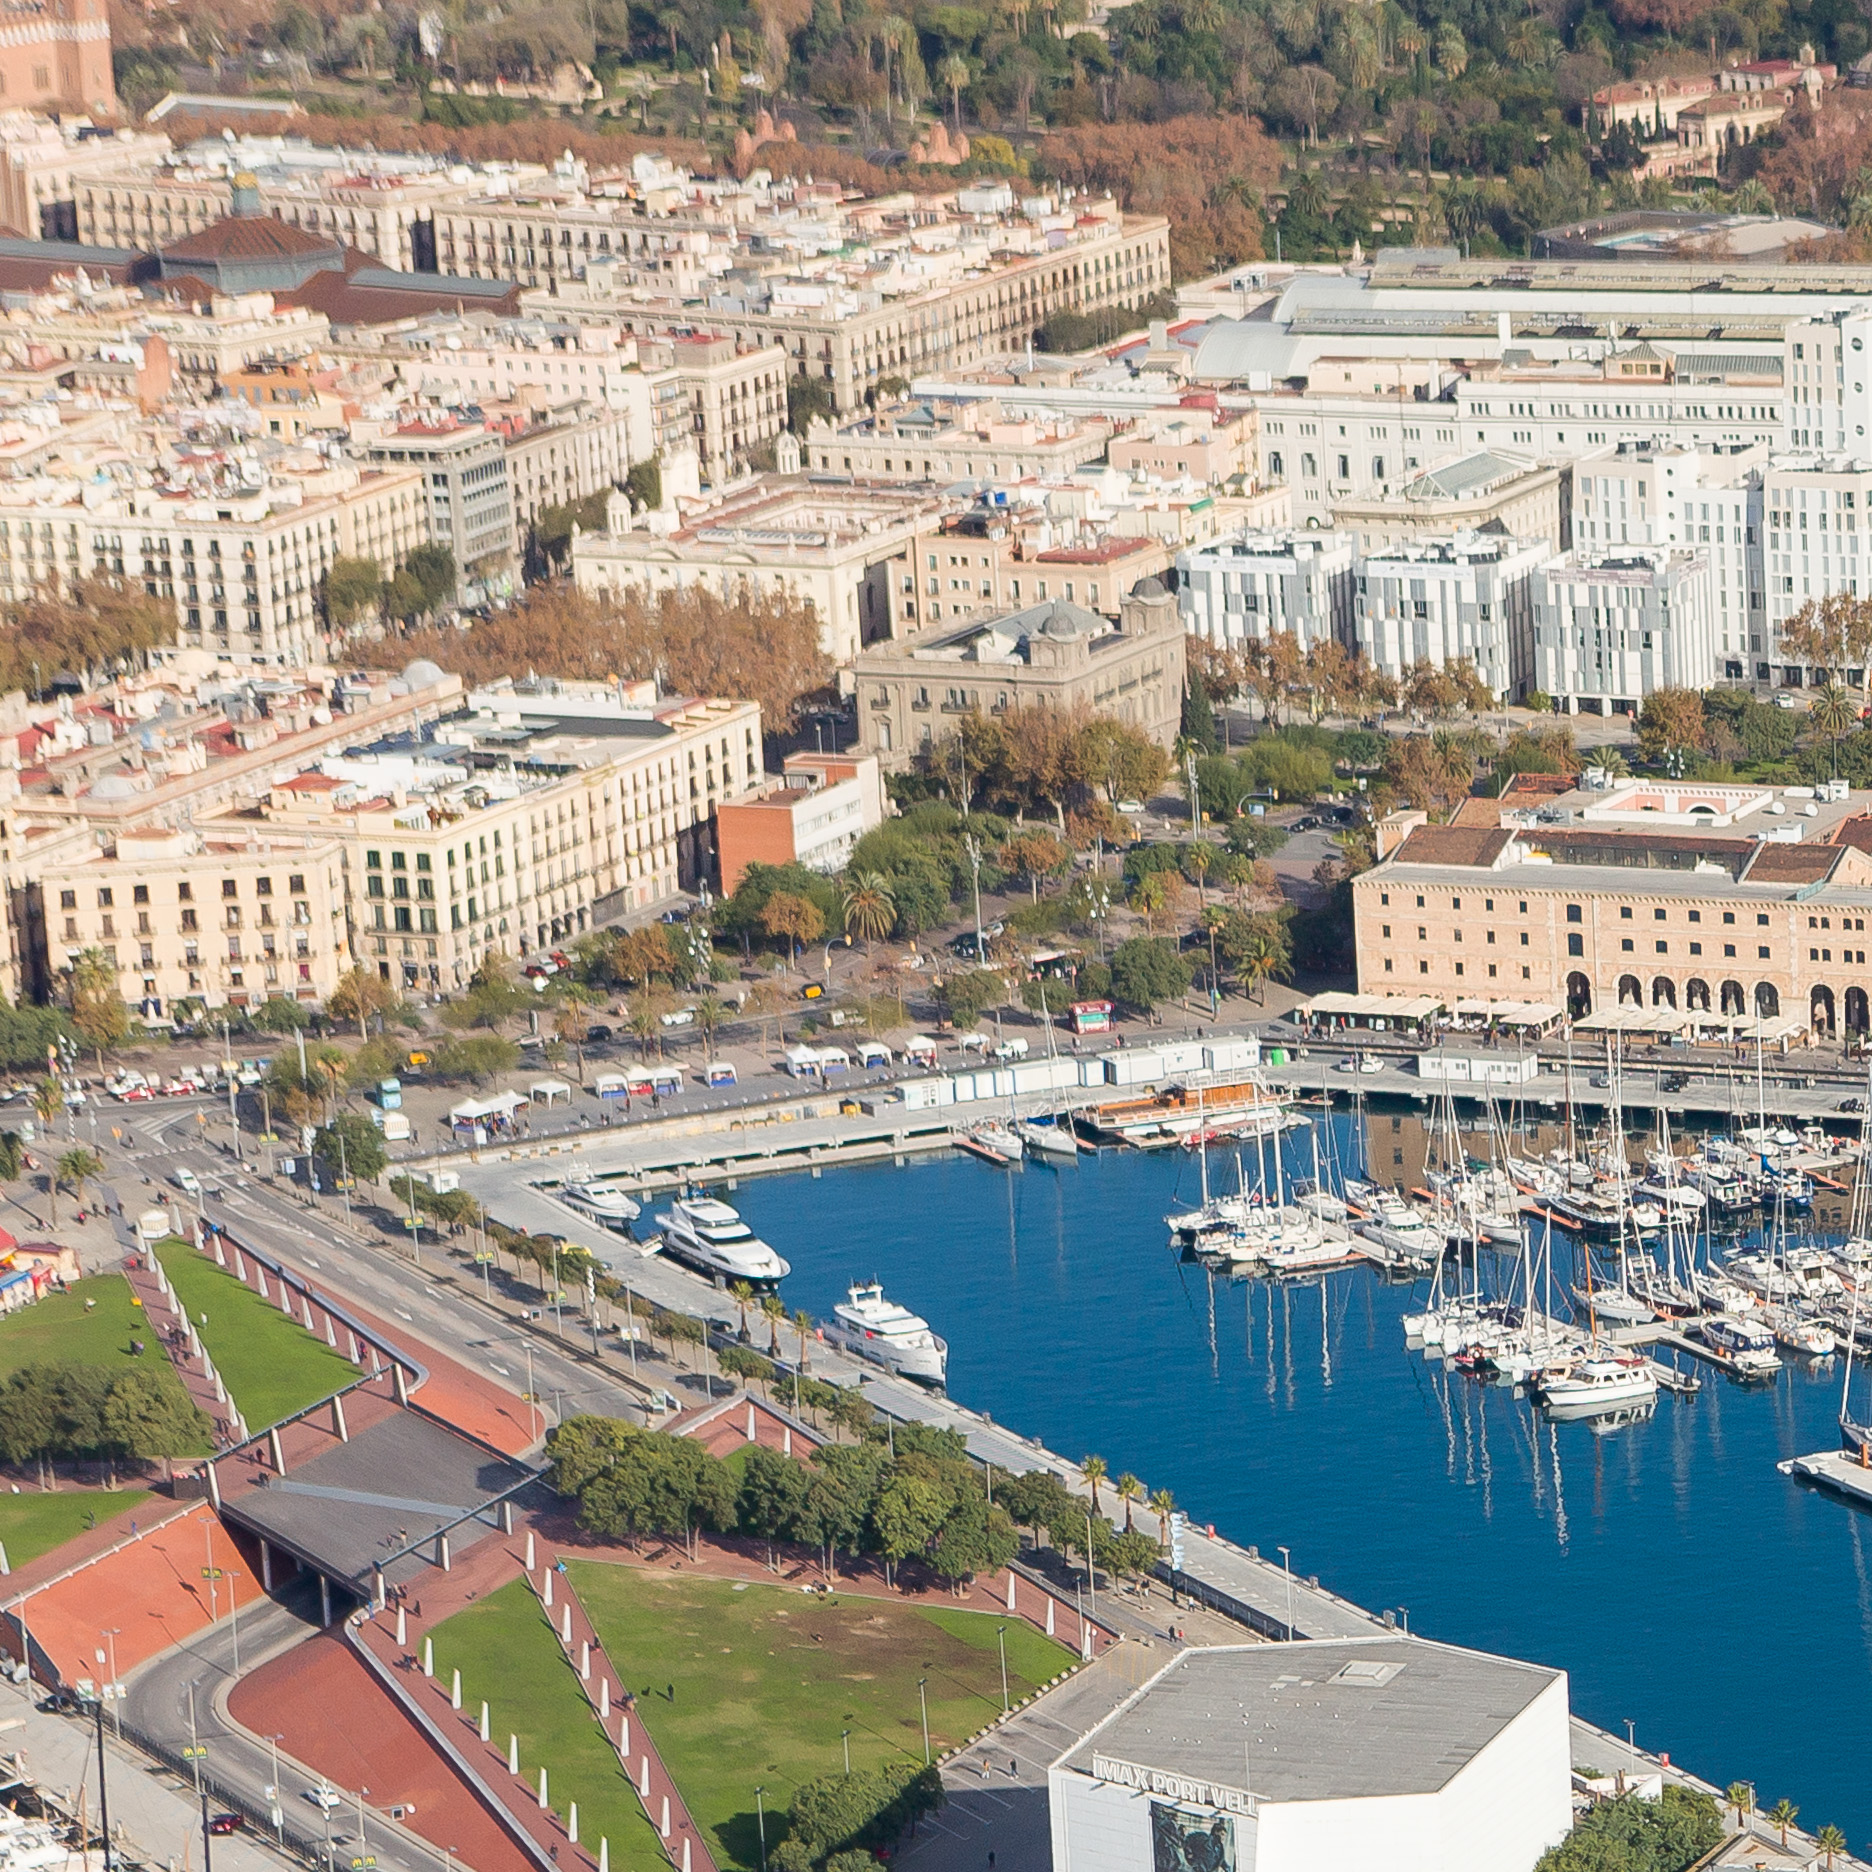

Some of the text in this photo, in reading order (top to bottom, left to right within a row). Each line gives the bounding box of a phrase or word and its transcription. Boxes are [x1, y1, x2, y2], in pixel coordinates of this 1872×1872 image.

[1092, 1757, 1258, 1817] IMAX PORT VELL
